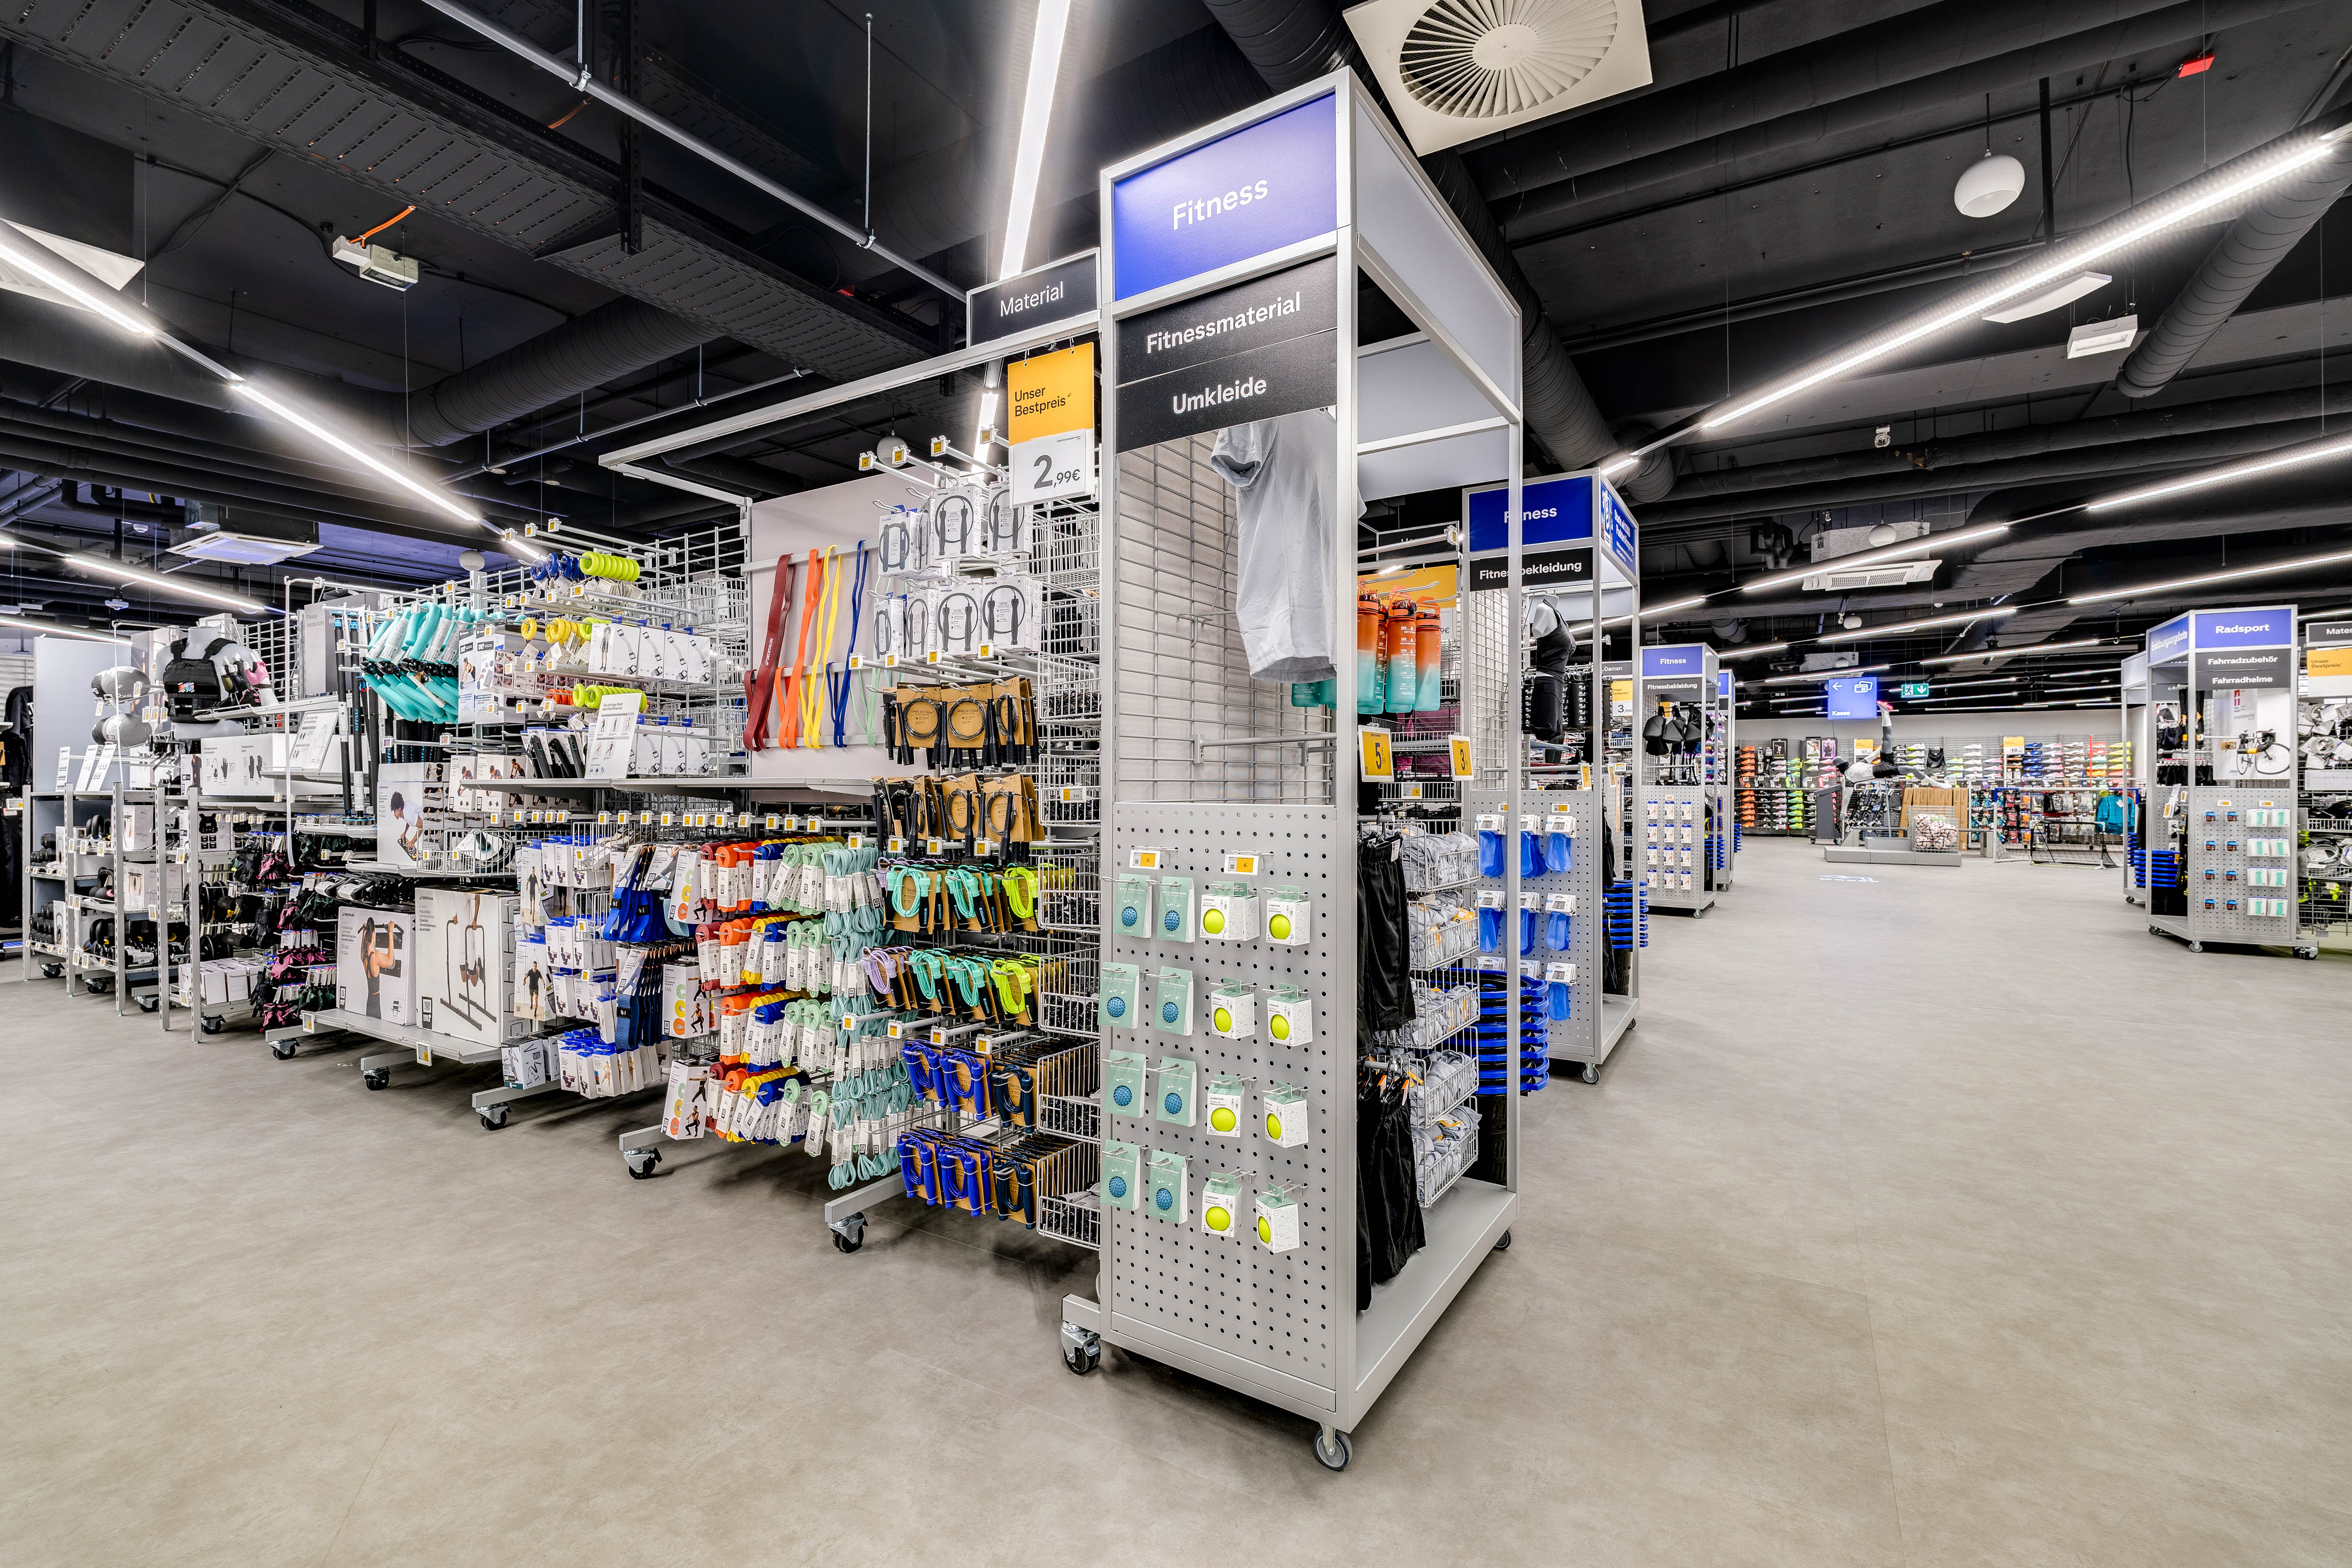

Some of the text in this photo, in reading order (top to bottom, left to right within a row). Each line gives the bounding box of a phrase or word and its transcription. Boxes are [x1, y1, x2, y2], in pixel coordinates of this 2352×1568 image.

[1173, 178, 1269, 231] Fitness
[1000, 281, 1064, 317] Material
[1147, 291, 1301, 354] Fitnessmaterial
[1014, 385, 1046, 402] Unser
[1173, 376, 1267, 414] Umkleide
[1014, 395, 1066, 417] Bestpreis
[1034, 455, 1080, 489] 2,99€
[1504, 506, 1558, 523] Fness
[1479, 561, 1582, 580] Fitneekleidung
[2215, 623, 2270, 635] Radsport
[2207, 656, 2278, 665] Fahrradzubehör
[2212, 675, 2273, 685] Fahrradhelme
[1375, 742, 1382, 770] 5
[1460, 748, 1465, 771] 3
